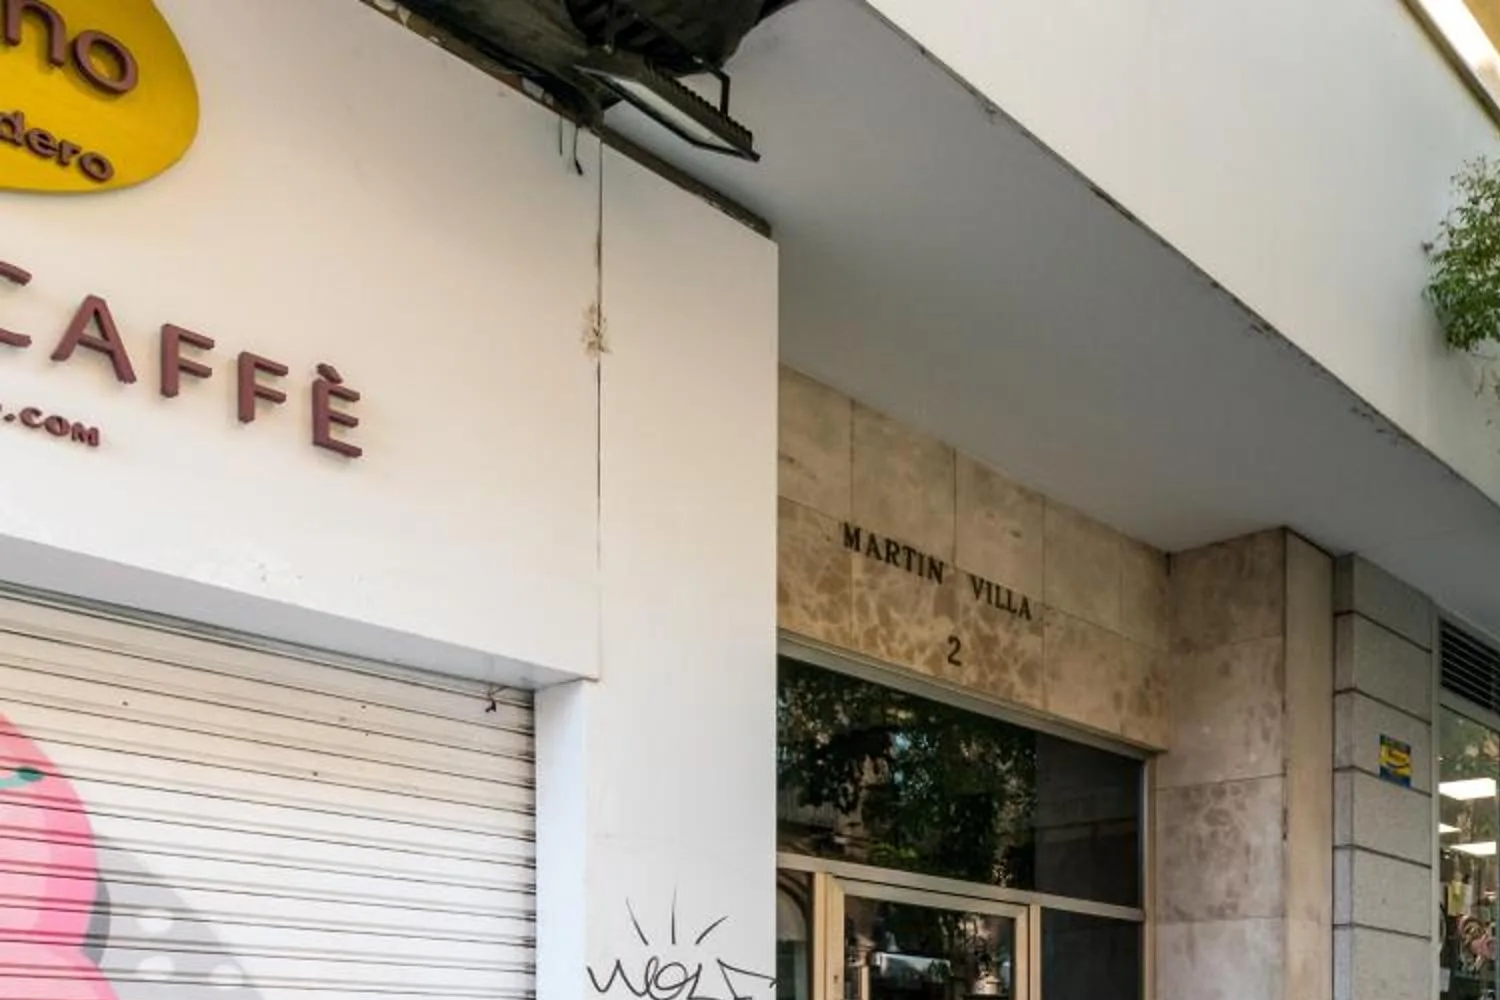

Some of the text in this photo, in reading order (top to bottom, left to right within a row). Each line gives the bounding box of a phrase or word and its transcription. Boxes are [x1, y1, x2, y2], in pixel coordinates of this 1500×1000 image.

[843, 521, 1032, 620] MARTIN VILLA
[947, 634, 962, 667] 2
